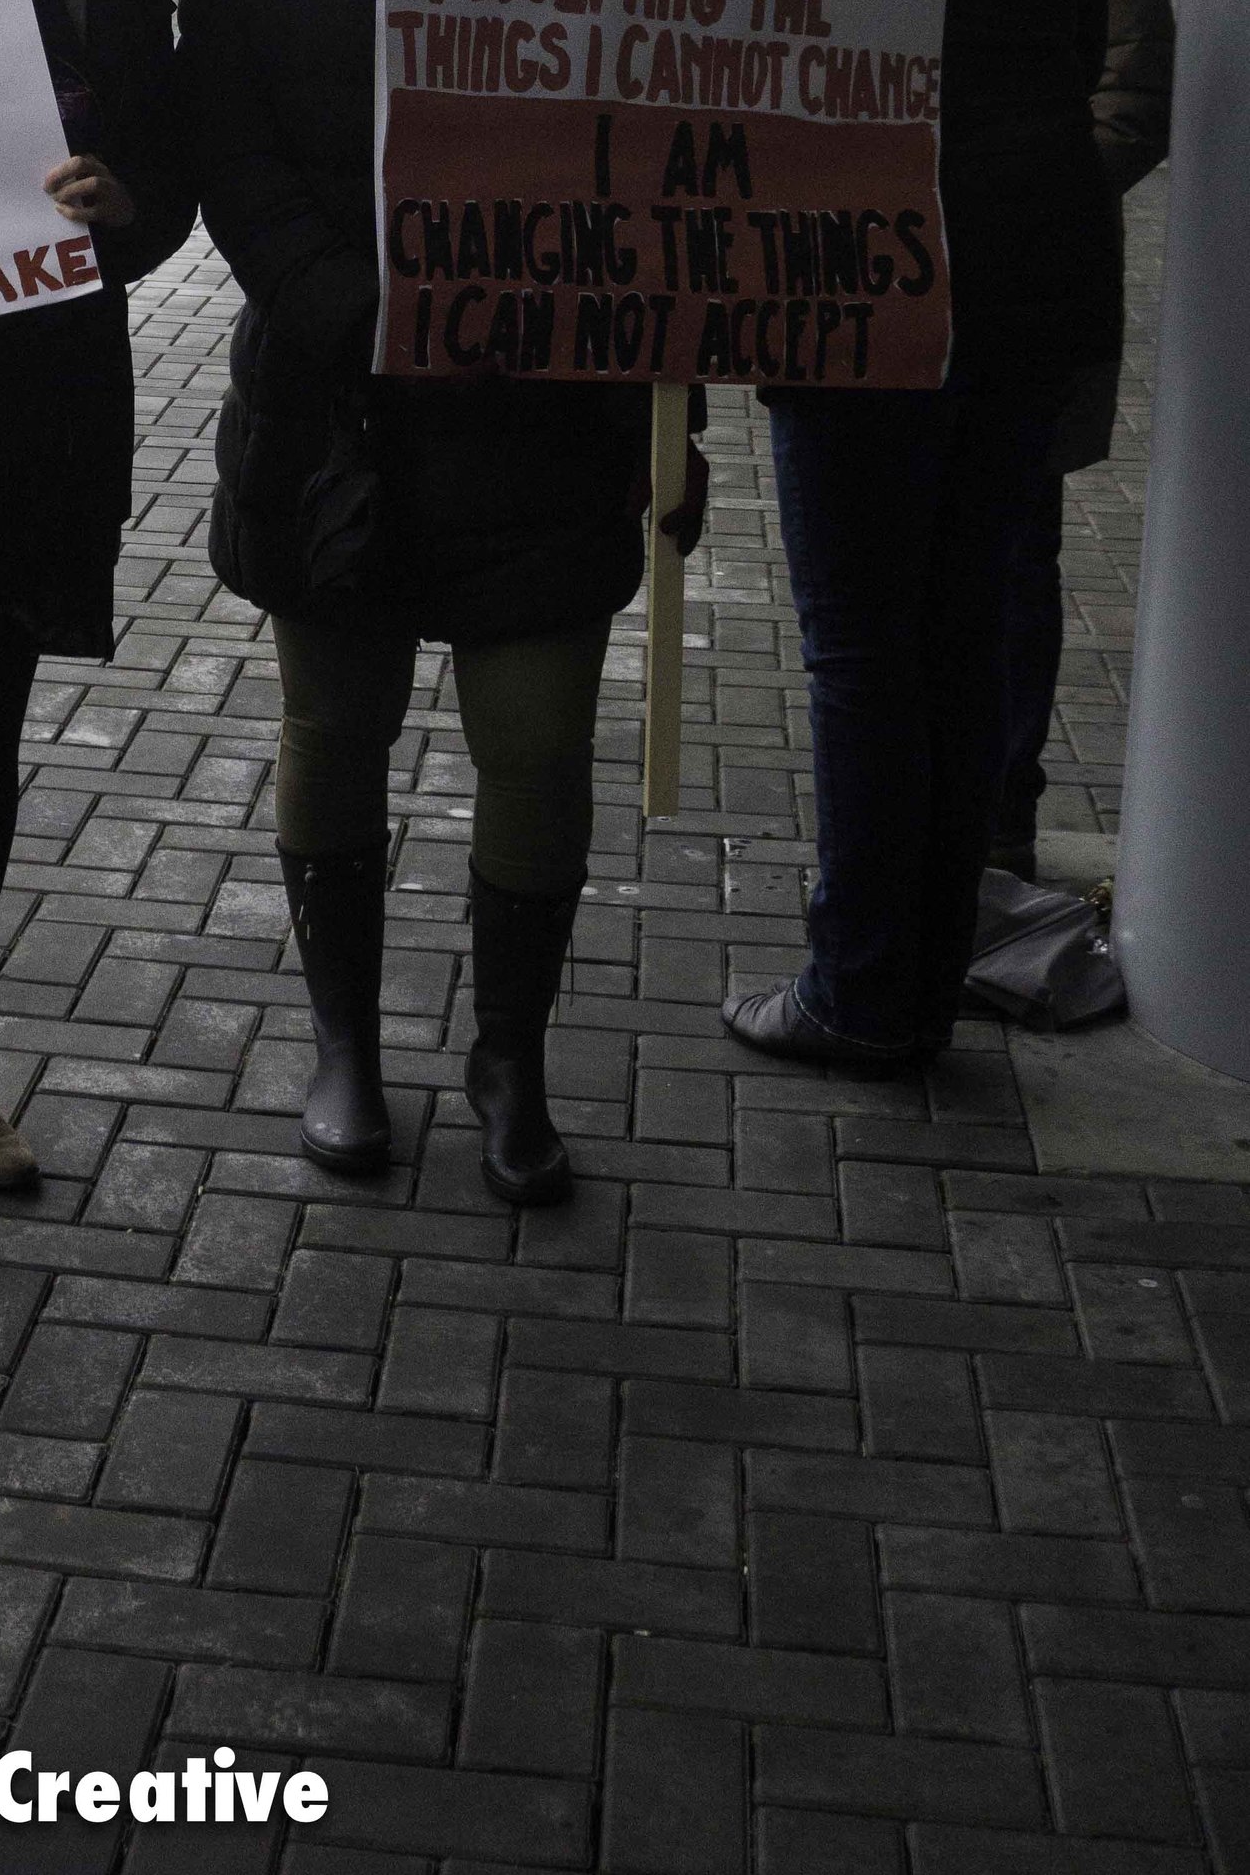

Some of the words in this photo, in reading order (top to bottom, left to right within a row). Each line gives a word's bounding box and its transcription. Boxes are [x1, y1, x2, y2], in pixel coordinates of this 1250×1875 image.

[388, 11, 571, 92] THINGS
[586, 24, 602, 96] I
[798, 45, 941, 120] CHANGE
[595, 114, 612, 197] I
[662, 121, 752, 199] AM
[390, 199, 637, 286] CHANGING
[651, 206, 740, 294] THE
[747, 209, 934, 297] THINGS
[415, 285, 432, 368] I
[443, 285, 555, 372] CAN
[573, 291, 676, 374] NOT
[696, 300, 873, 380] ACCEPT
